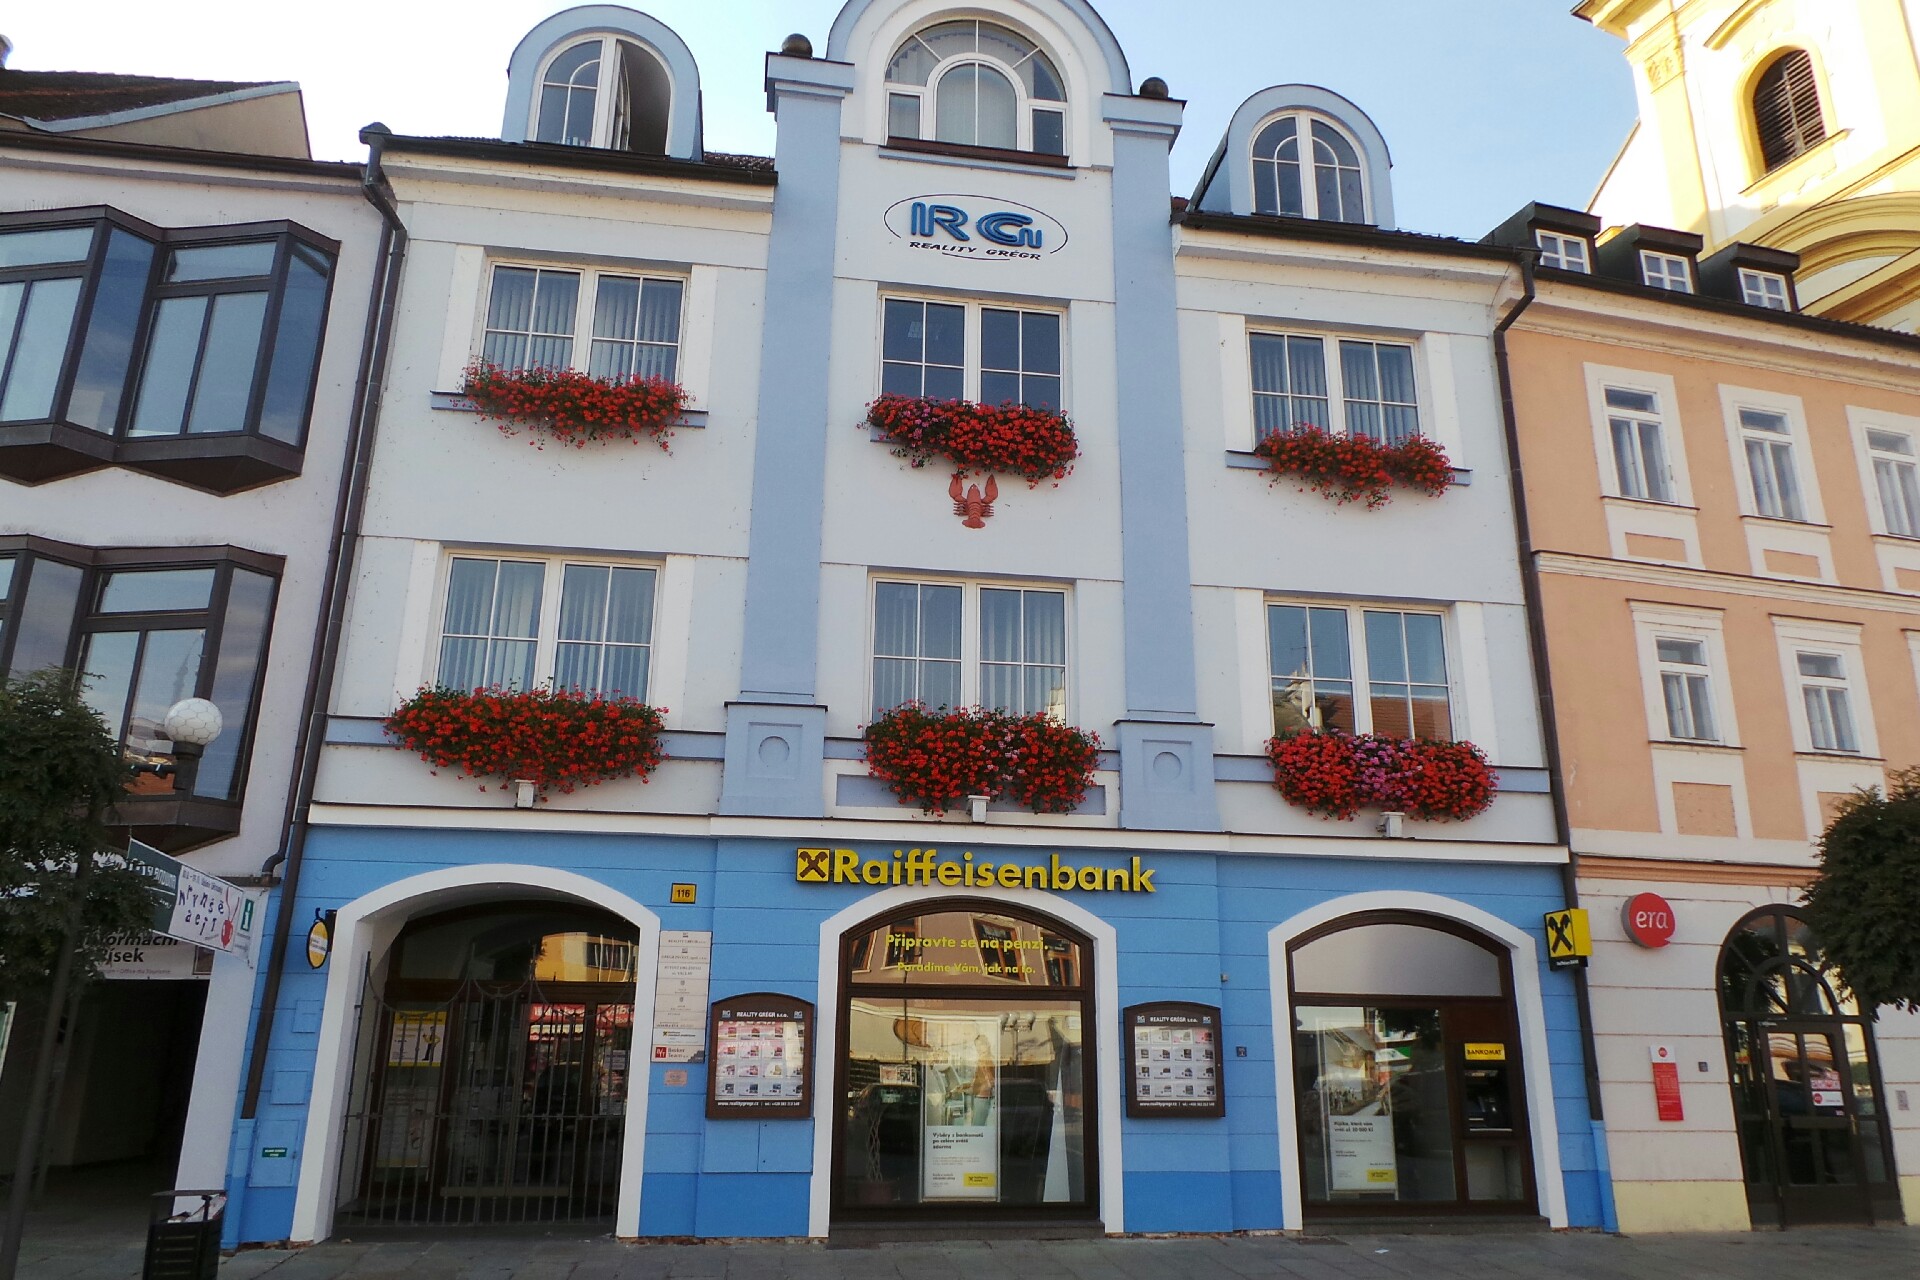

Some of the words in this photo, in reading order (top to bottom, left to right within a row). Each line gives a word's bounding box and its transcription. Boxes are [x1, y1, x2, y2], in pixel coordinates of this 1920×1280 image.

[909, 241, 977, 254] REALITY
[985, 248, 1042, 261] GRÉGR
[833, 849, 1157, 893] Raiffeisenbank
[677, 889, 691, 898] 116
[1635, 910, 1668, 929] era
[885, 933, 956, 951] Připravte
[960, 938, 976, 948] se
[980, 938, 999, 949] na
[1003, 936, 1049, 952] penzi.
[103, 947, 145, 963] ísek
[897, 961, 950, 972] Poradíme
[954, 961, 981, 974] Vám,
[984, 962, 1002, 976] jak
[1004, 965, 1018, 973] na
[1021, 963, 1036, 974] to.
